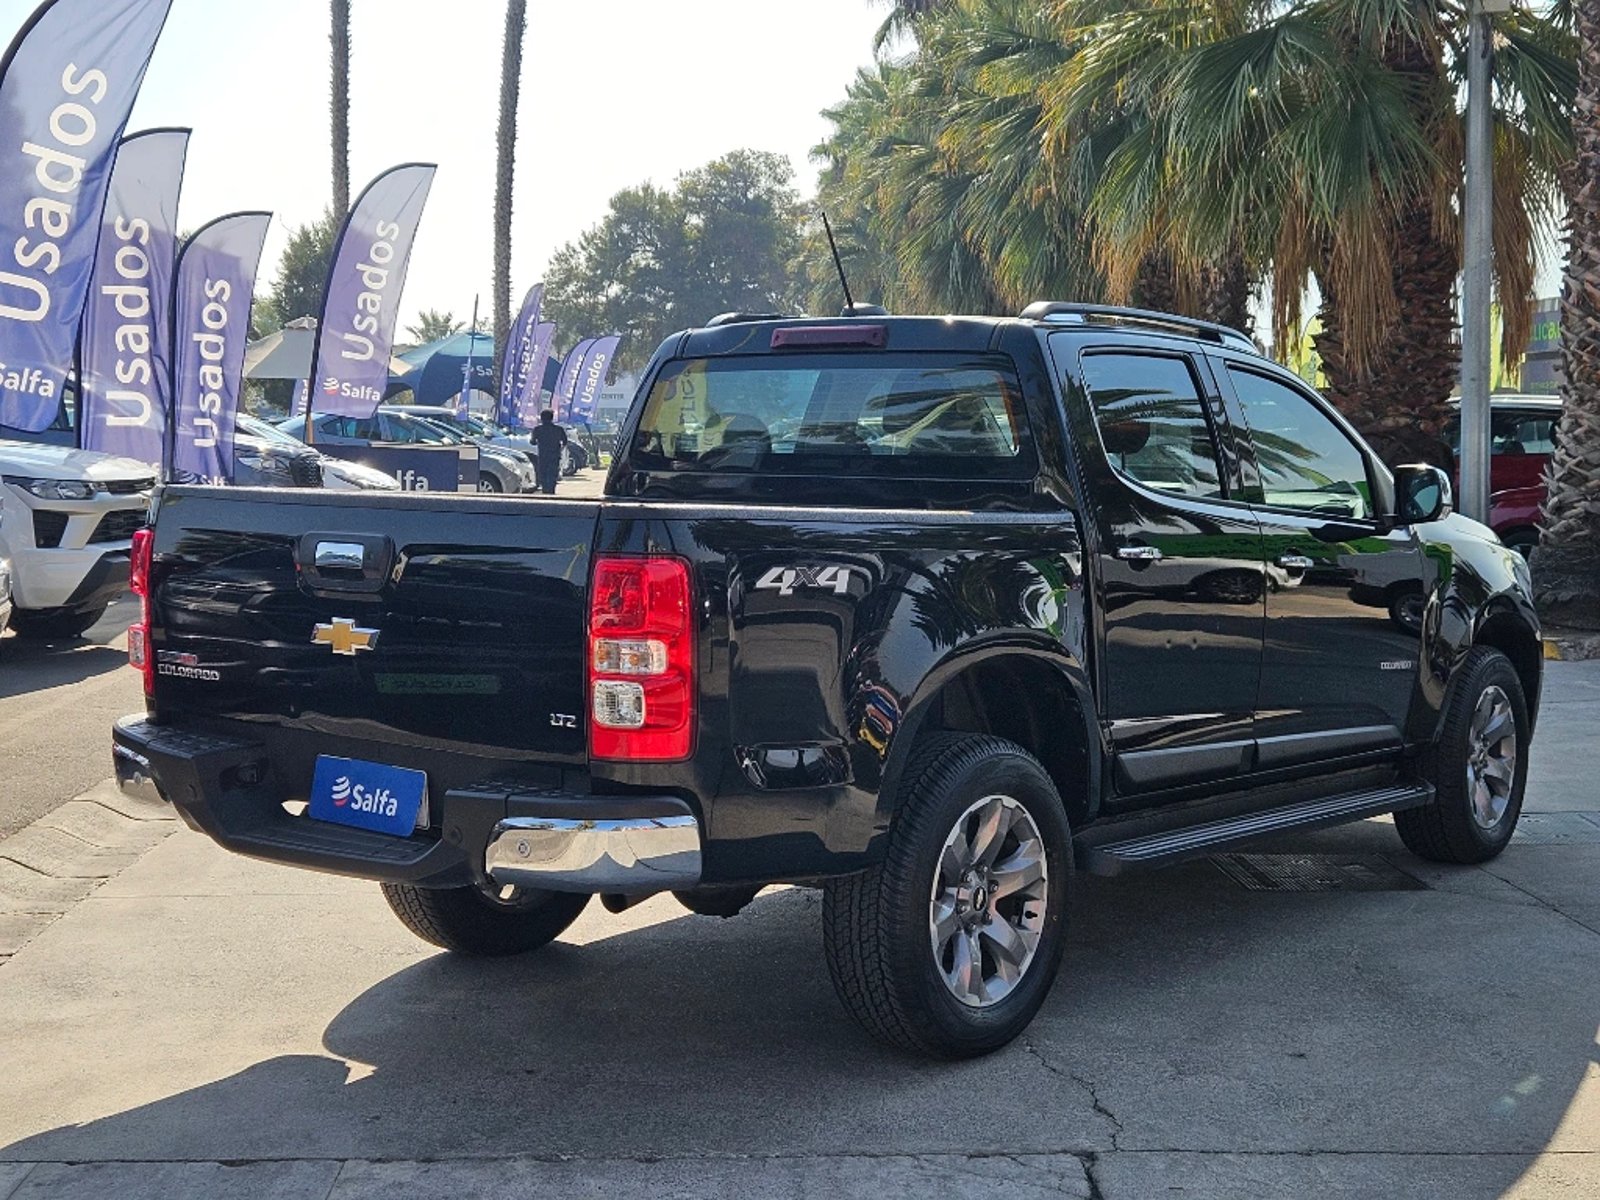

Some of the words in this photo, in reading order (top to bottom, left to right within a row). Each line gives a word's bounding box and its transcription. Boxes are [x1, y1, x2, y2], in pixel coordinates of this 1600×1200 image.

[0, 63, 107, 322] Usados
[342, 219, 400, 362] Usados
[102, 215, 151, 428] Usados
[193, 278, 231, 448] Usados
[581, 353, 606, 403] Usados
[0, 367, 54, 397] alfa
[341, 382, 381, 401] Salfa
[396, 469, 429, 491] lfa
[157, 663, 220, 681] COLORADO
[549, 712, 577, 728] LTZ
[350, 784, 399, 817] Salfa
